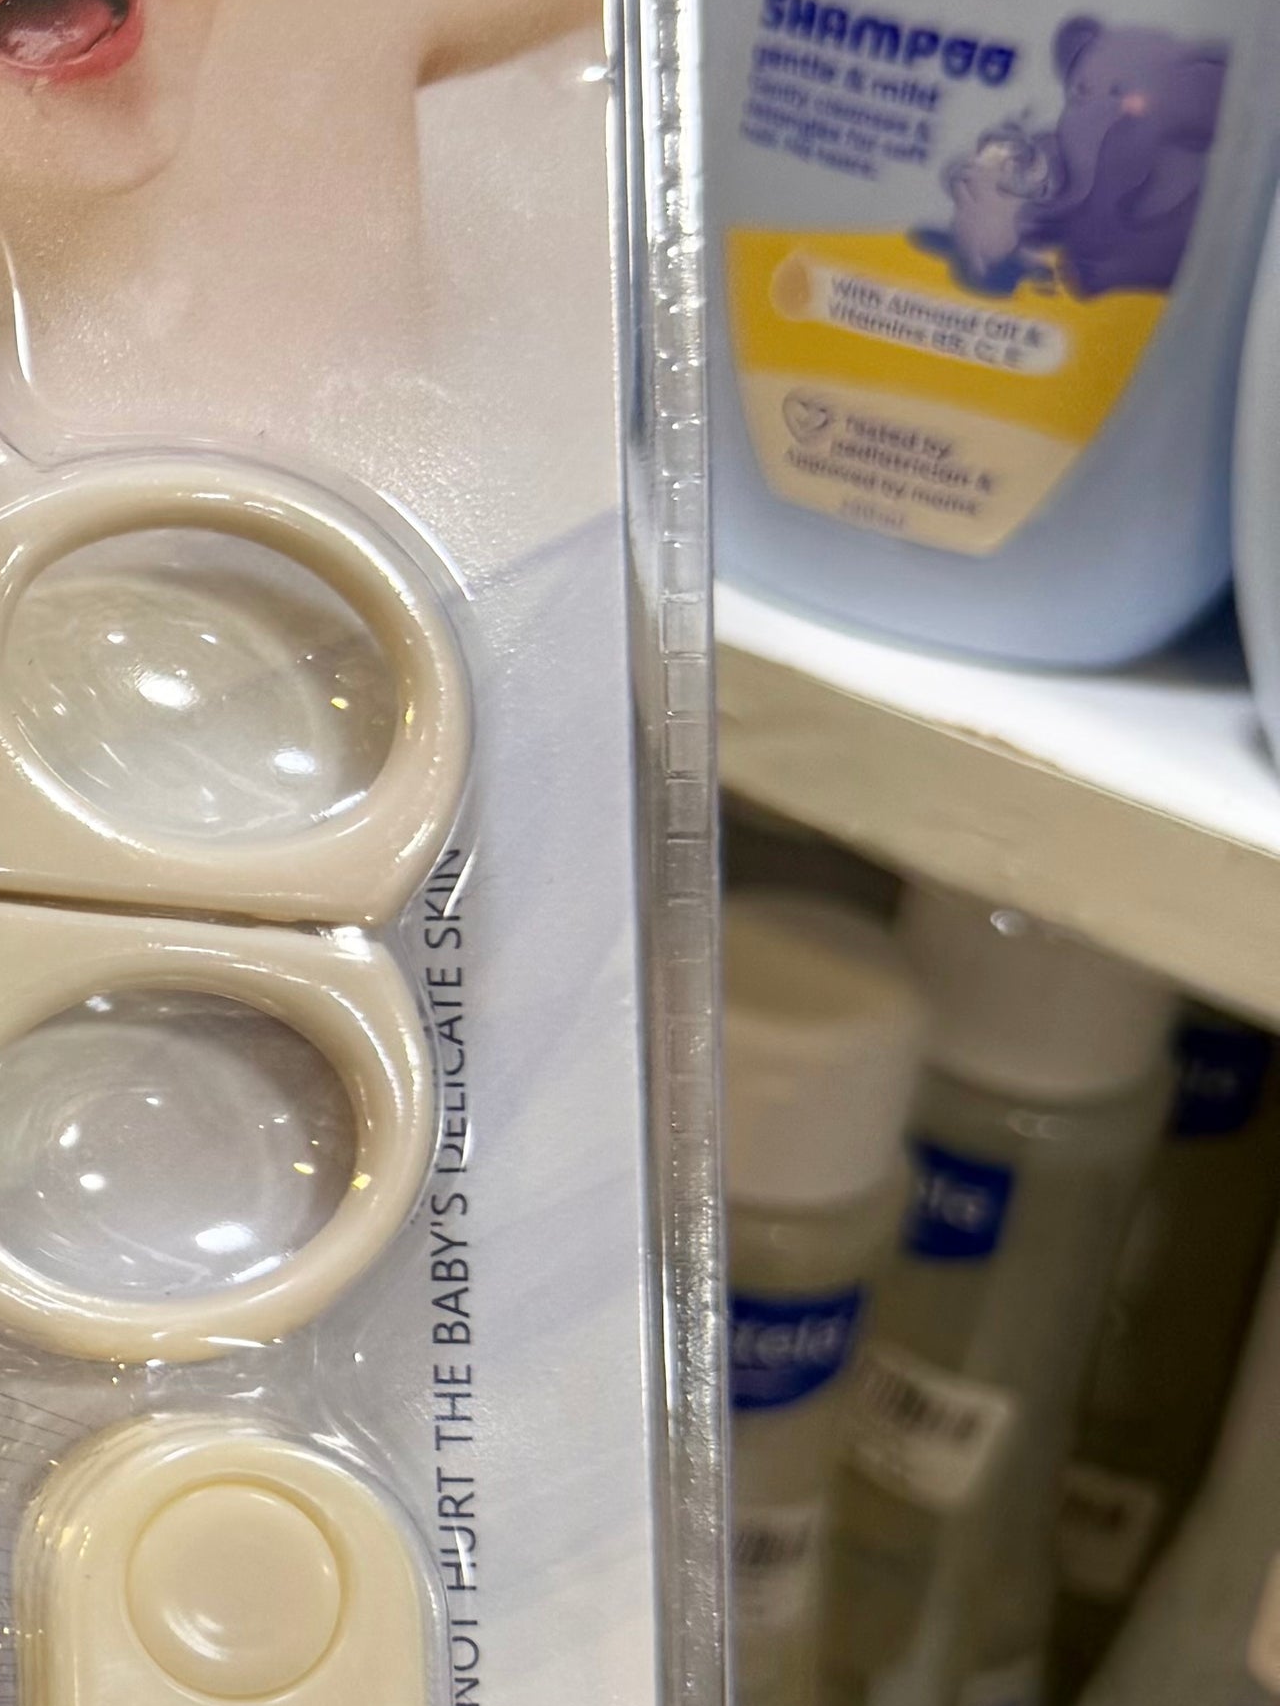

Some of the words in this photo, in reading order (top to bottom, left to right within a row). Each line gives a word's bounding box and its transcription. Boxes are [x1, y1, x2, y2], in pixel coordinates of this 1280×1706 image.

[828, 302, 927, 342] Vitamins
[831, 276, 883, 307] With
[889, 294, 979, 330] Almond
[424, 848, 462, 950] SKIN
[426, 967, 469, 1173] DELICATE
[430, 1192, 473, 1346] BABY'S
[433, 1362, 474, 1454] THE
[437, 1466, 478, 1592] HURT
